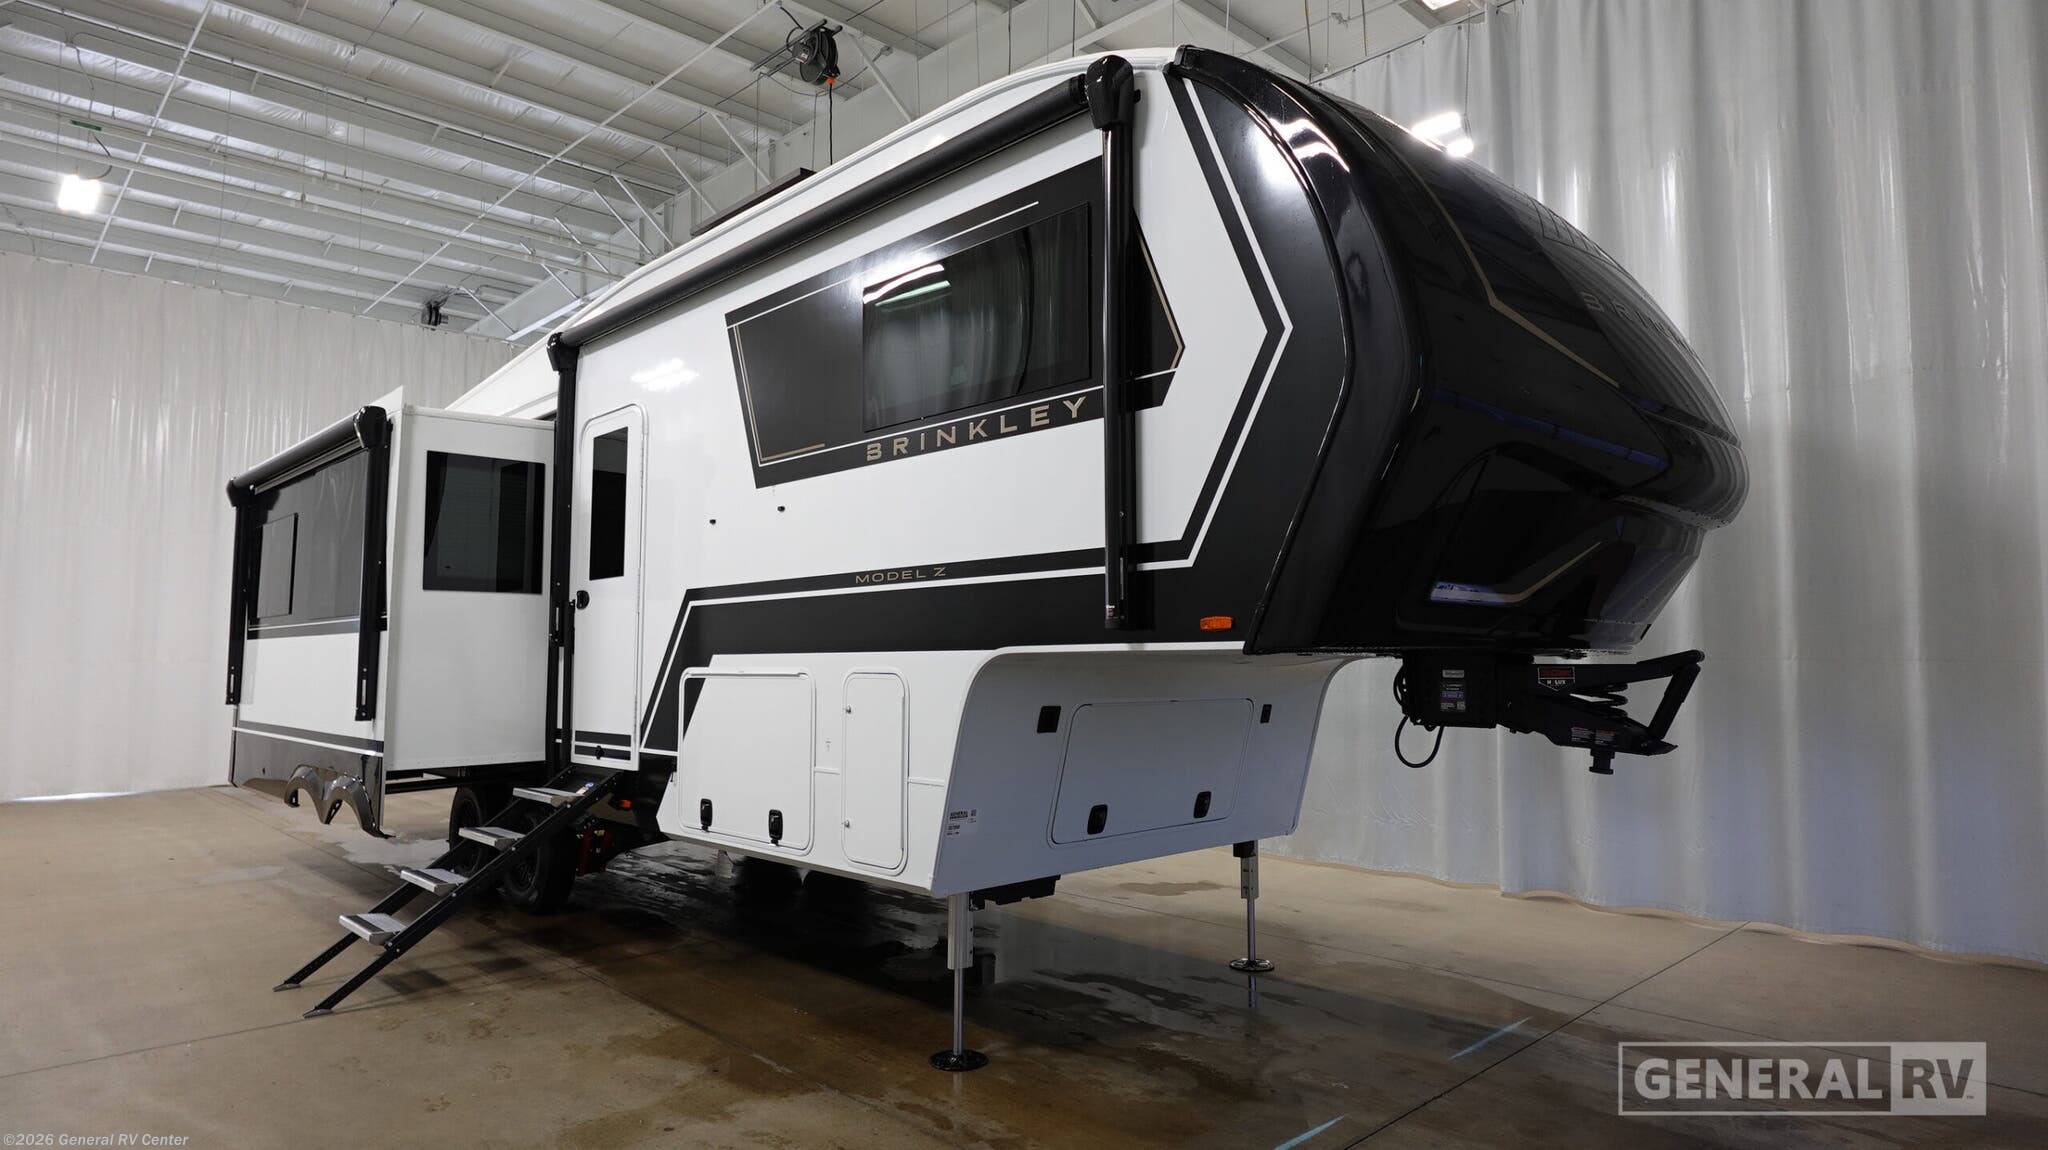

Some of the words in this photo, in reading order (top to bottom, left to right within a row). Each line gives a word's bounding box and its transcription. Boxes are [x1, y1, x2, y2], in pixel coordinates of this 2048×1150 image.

[866, 396, 1086, 461] BRINKLEY
[855, 569, 926, 584] MODEL
[933, 567, 946, 577] Z
